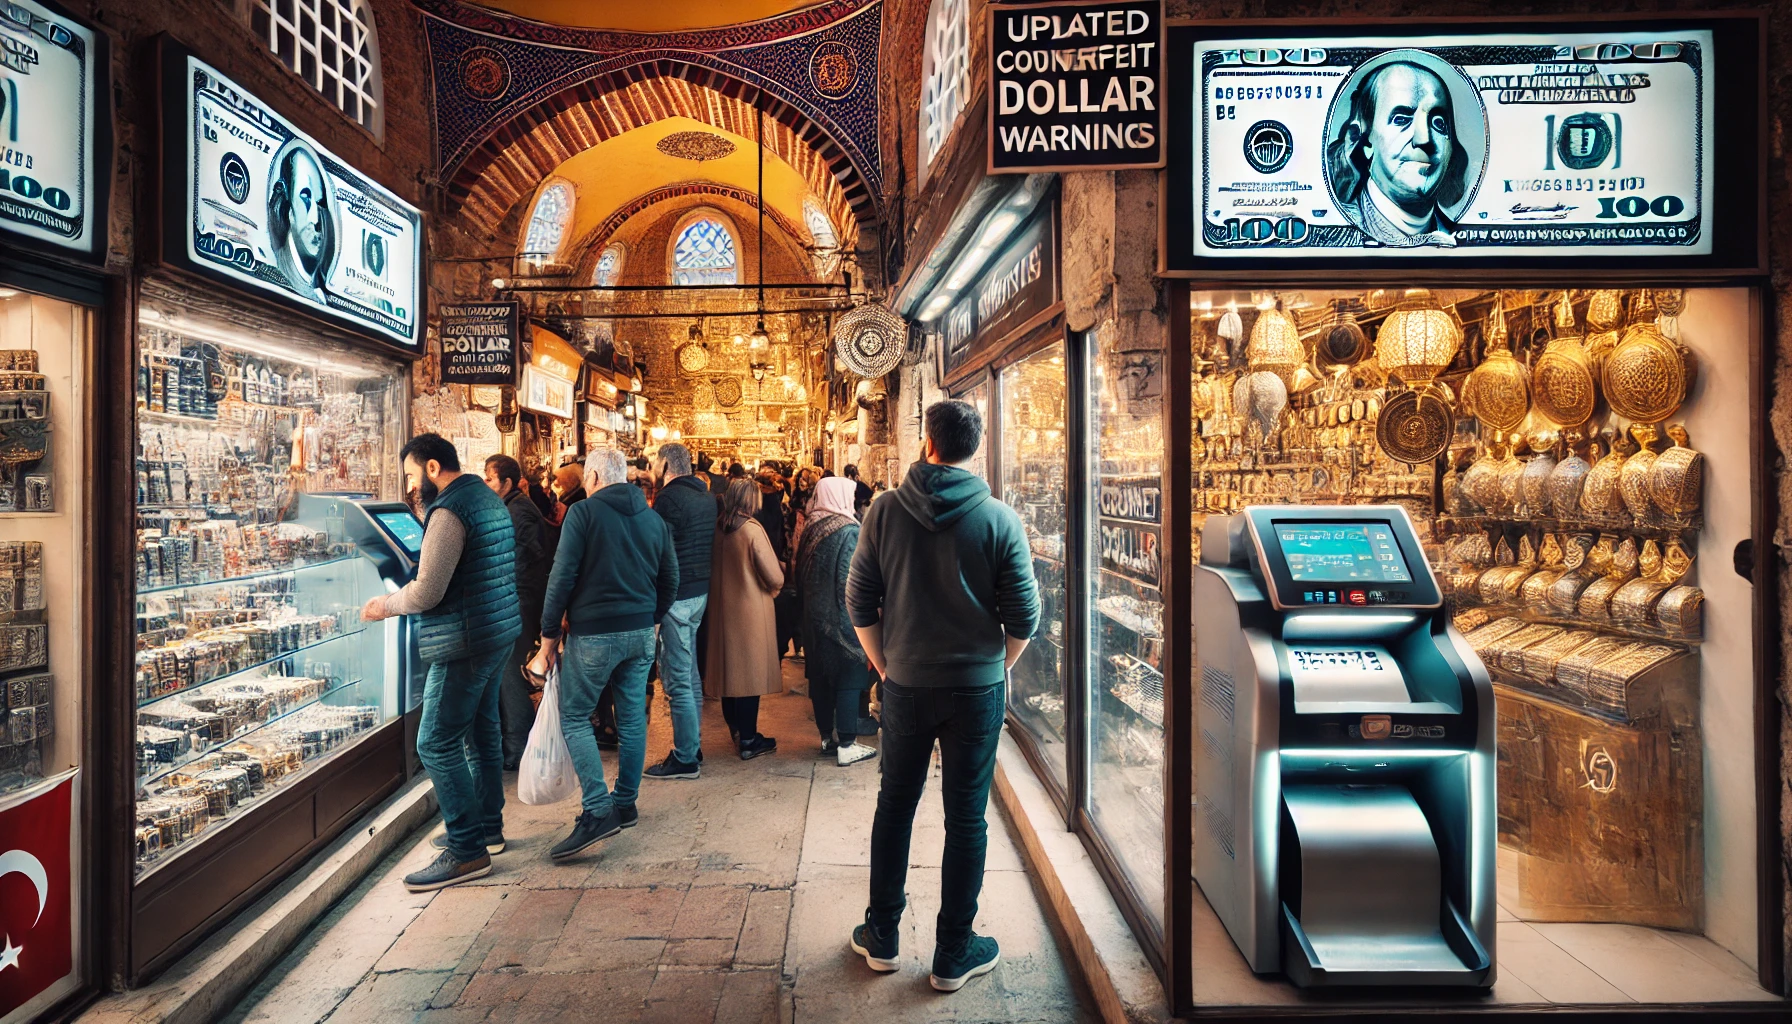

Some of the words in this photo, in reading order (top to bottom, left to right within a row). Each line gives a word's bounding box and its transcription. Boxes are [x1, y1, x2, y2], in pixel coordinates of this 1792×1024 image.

[1000, 75, 1156, 116] DOLLAR
[999, 122, 1156, 153] WARNINGS
[1596, 195, 1685, 219] 100
[1223, 217, 1309, 242] 100
